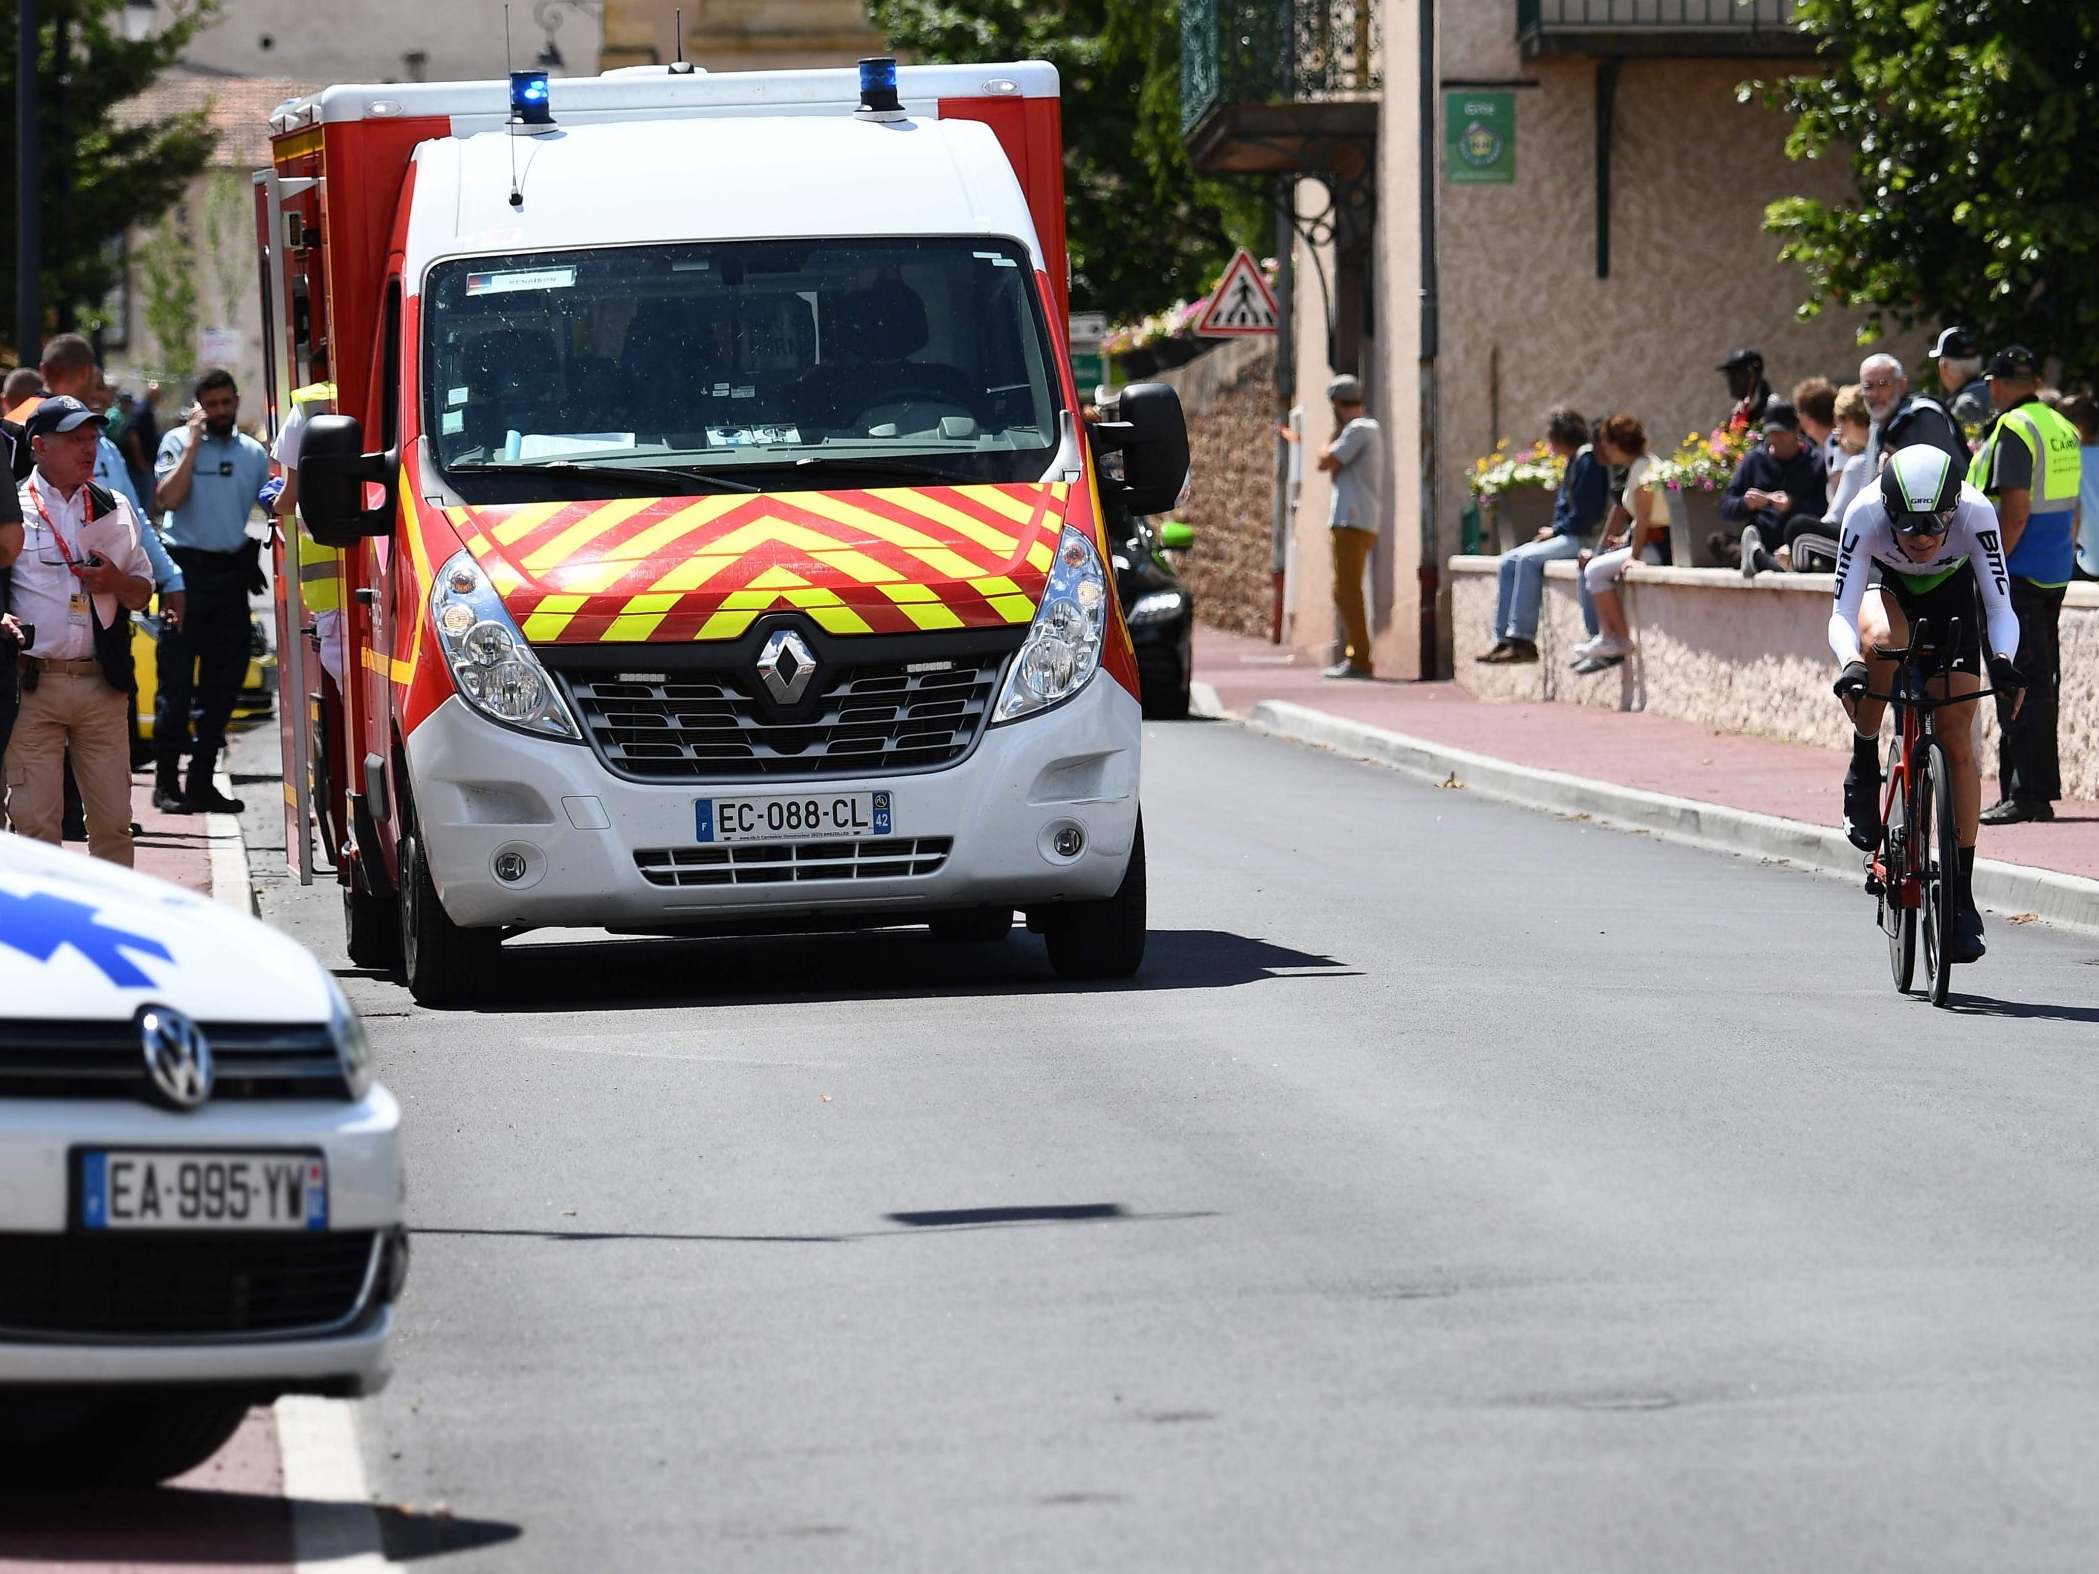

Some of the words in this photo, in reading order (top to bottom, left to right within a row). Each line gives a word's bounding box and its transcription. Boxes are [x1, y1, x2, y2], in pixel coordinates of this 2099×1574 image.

[1835, 528, 1859, 600] BMC
[1975, 530, 2010, 595] BMC
[701, 822, 707, 832] F
[719, 798, 868, 833] EC-088-CL
[875, 813, 889, 828] 42
